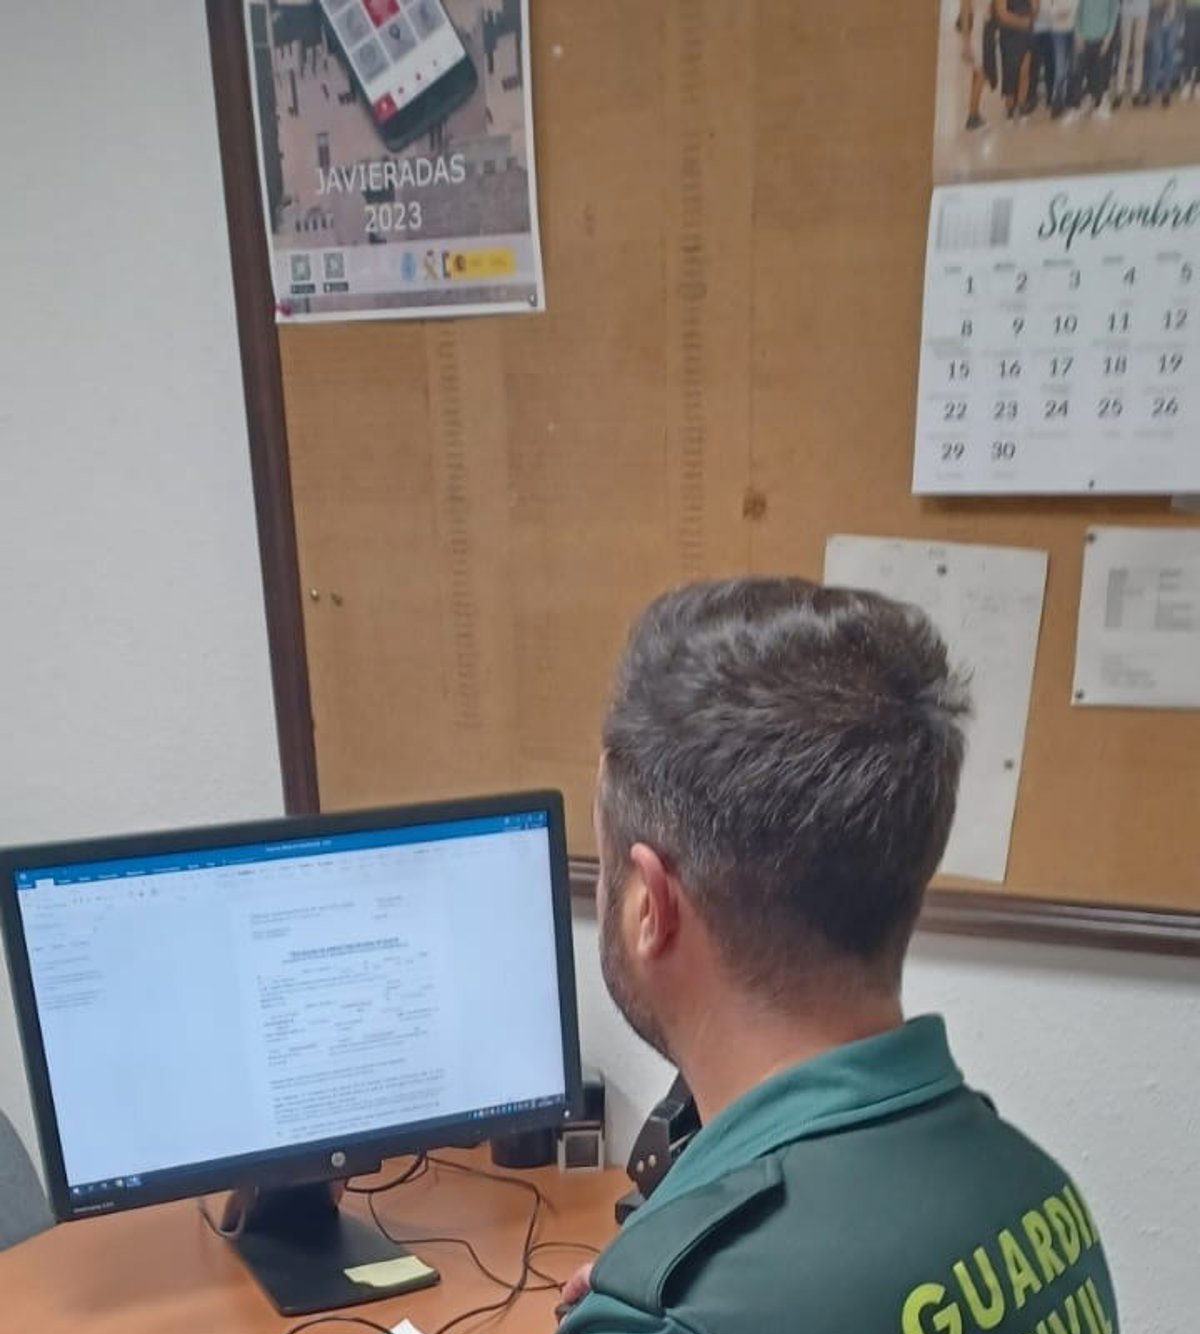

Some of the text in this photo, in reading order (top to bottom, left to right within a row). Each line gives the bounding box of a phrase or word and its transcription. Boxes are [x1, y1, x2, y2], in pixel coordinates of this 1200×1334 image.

[314, 153, 467, 196] JAVIERADAS
[363, 201, 423, 233] 2023
[965, 275, 974, 295] 1
[1015, 271, 1028, 294] 2
[1122, 265, 1136, 286] 4
[1012, 317, 1025, 336] 9
[1054, 315, 1078, 335] 10
[1108, 311, 1130, 333] 11
[1164, 309, 1188, 330] 12
[948, 352, 1184, 380] 15 16 17 18 19
[943, 396, 1179, 421] 22 23 24 25 26
[941, 441, 1016, 461] 29 30
